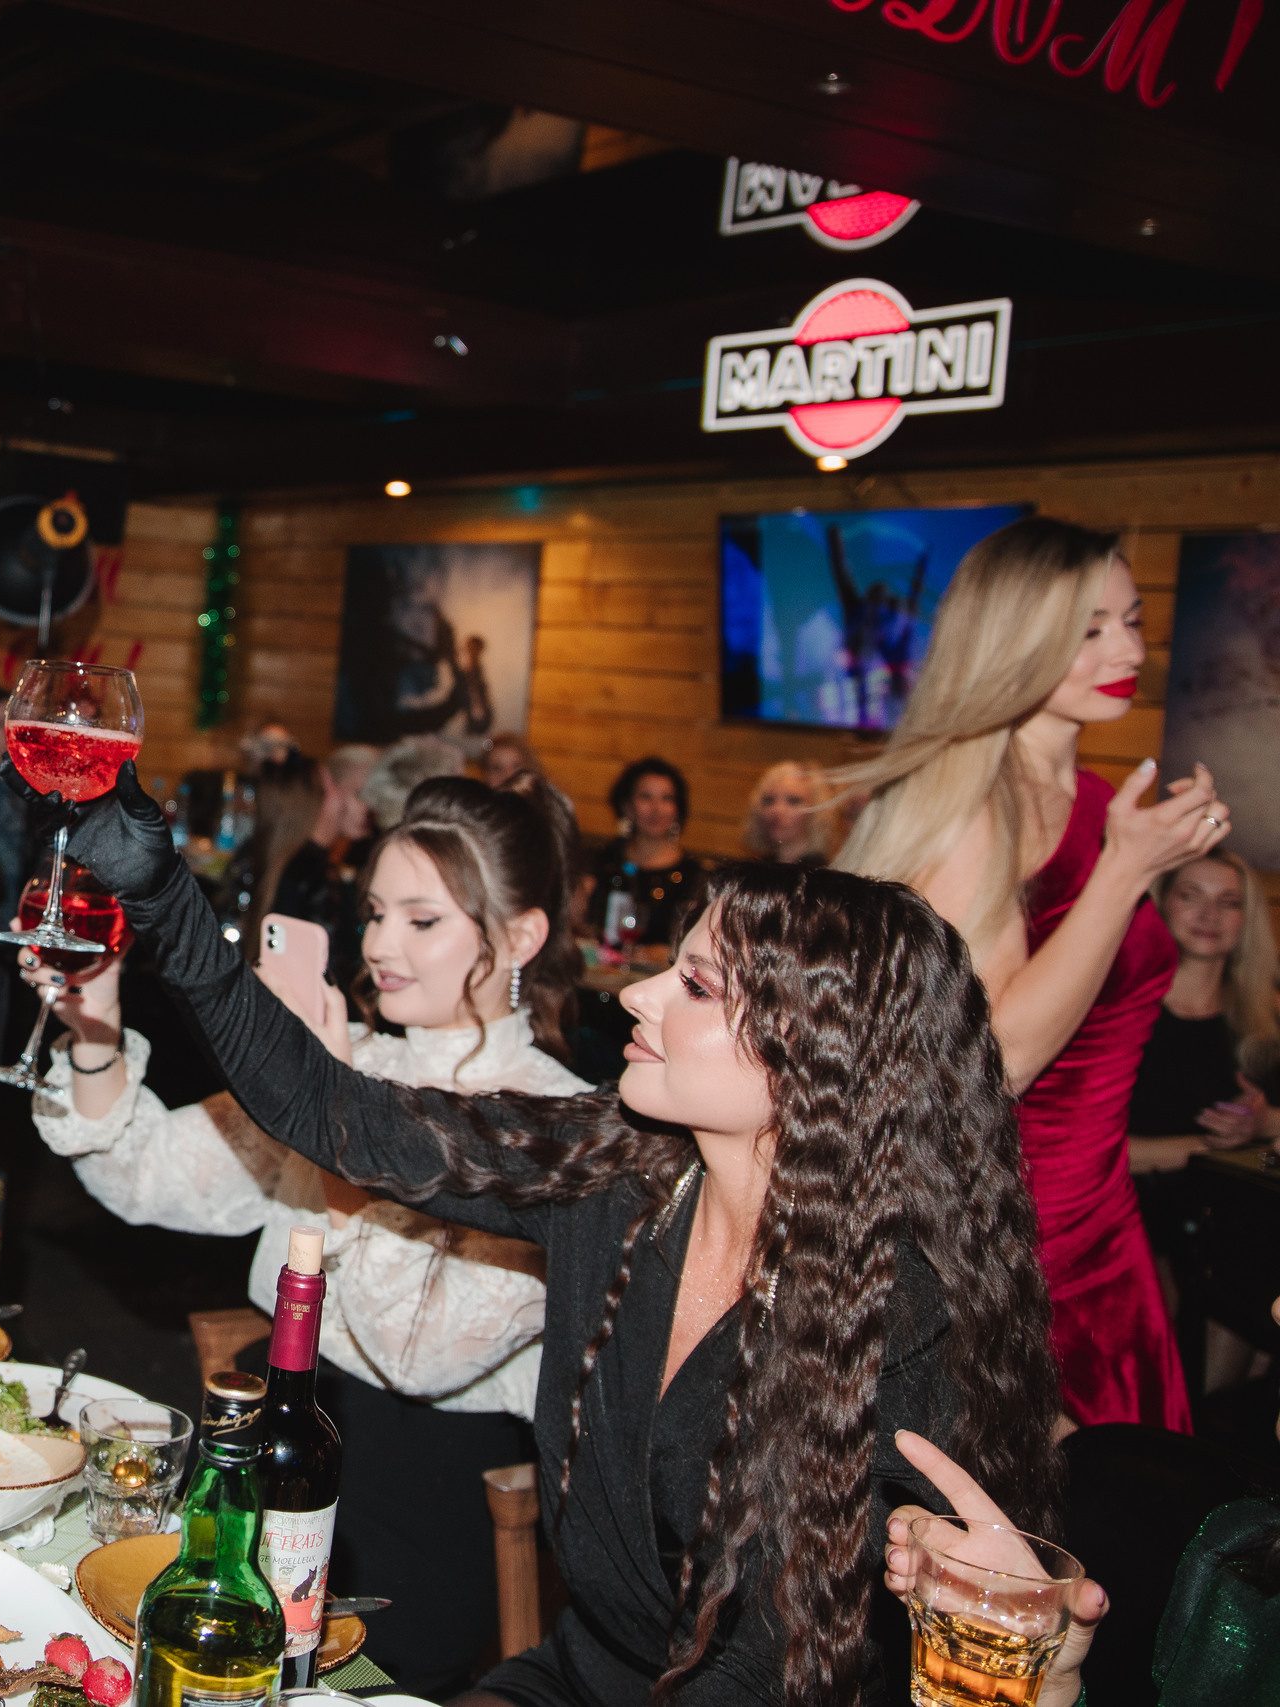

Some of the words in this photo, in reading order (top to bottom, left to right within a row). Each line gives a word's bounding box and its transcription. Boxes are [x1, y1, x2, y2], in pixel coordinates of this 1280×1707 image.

[717, 320, 996, 412] MARTINI
[281, 1529, 325, 1551] FRAIS
[272, 1554, 317, 1566] MOELLEUX
